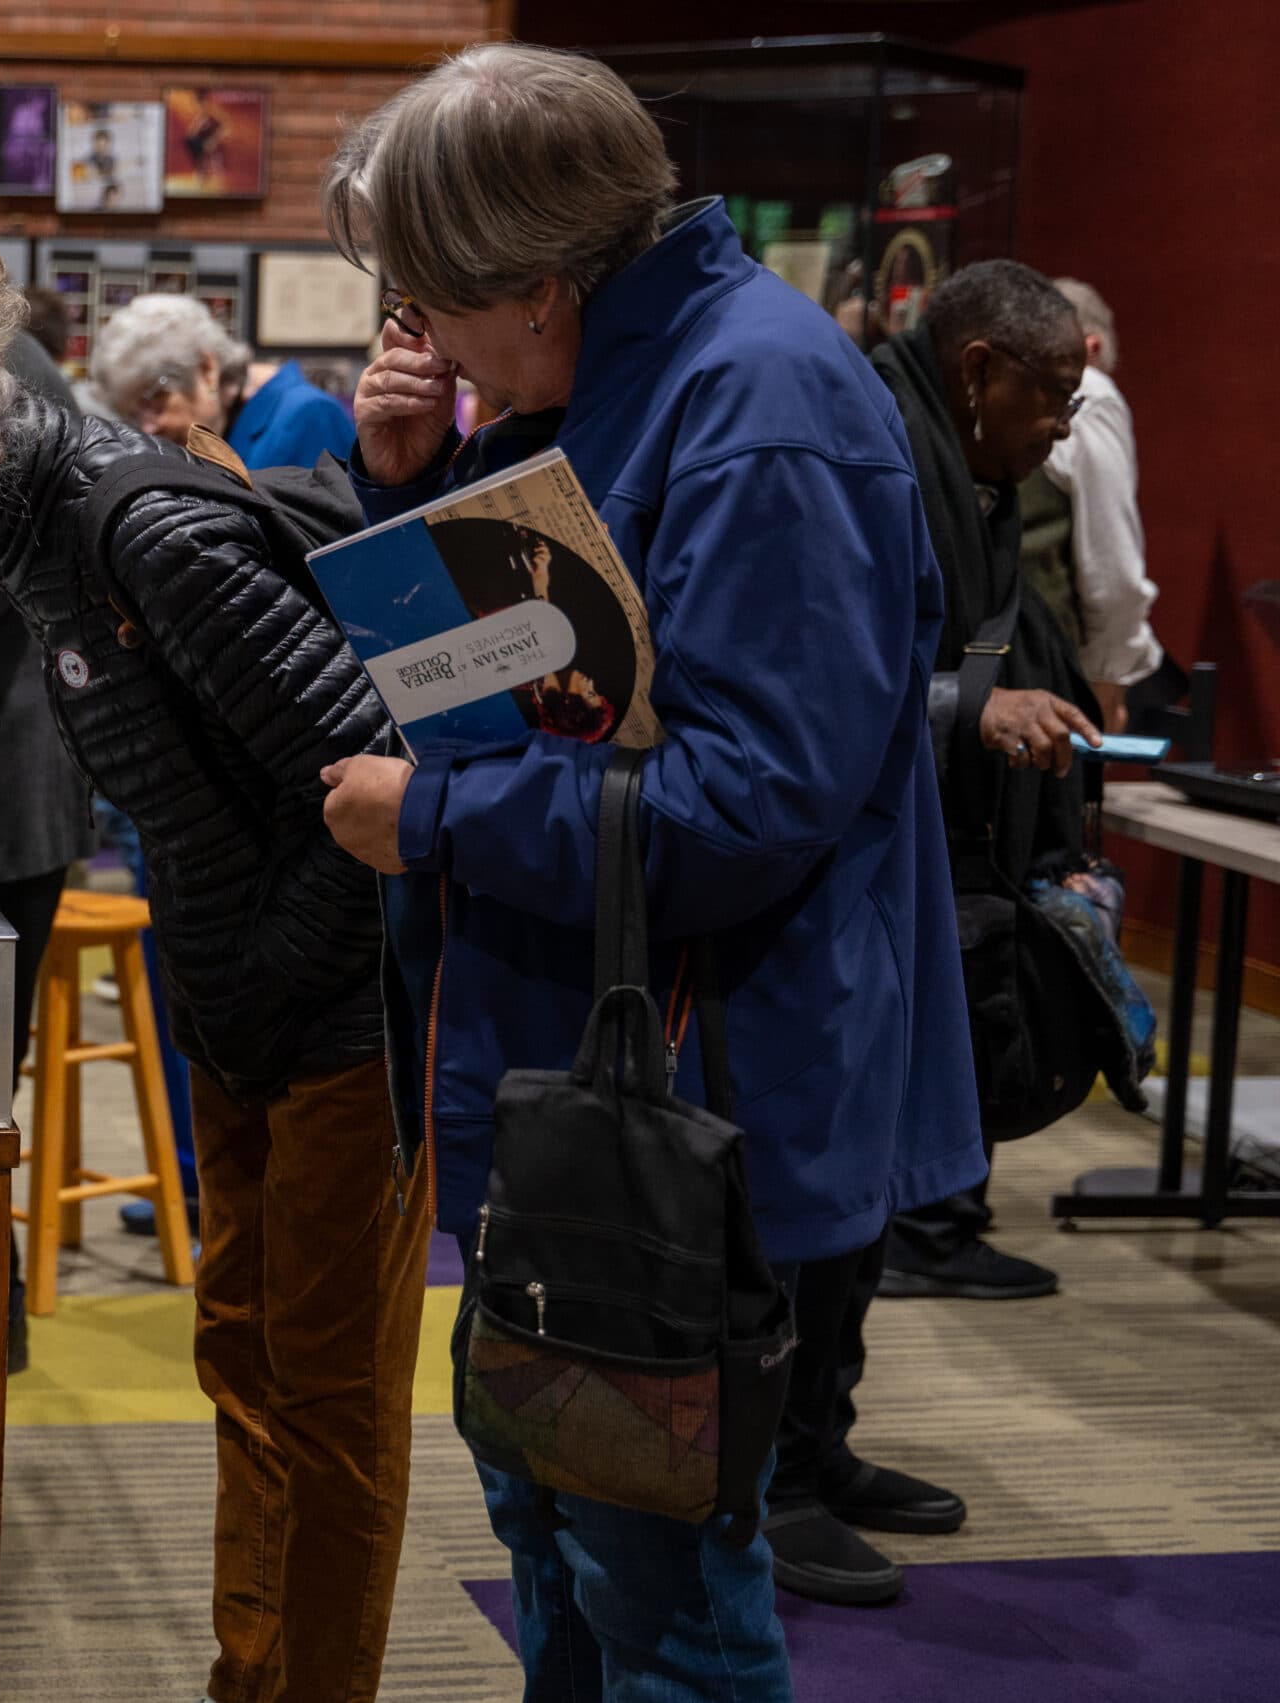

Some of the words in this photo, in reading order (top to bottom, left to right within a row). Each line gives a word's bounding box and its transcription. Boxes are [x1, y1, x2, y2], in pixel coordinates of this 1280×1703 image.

[465, 621, 532, 653] ARCHIVES
[499, 631, 539, 657] JANIS
[396, 651, 452, 678] COLLEGE
[472, 650, 498, 669] IAN
[519, 649, 548, 666] THE
[401, 663, 456, 689] BEREA
